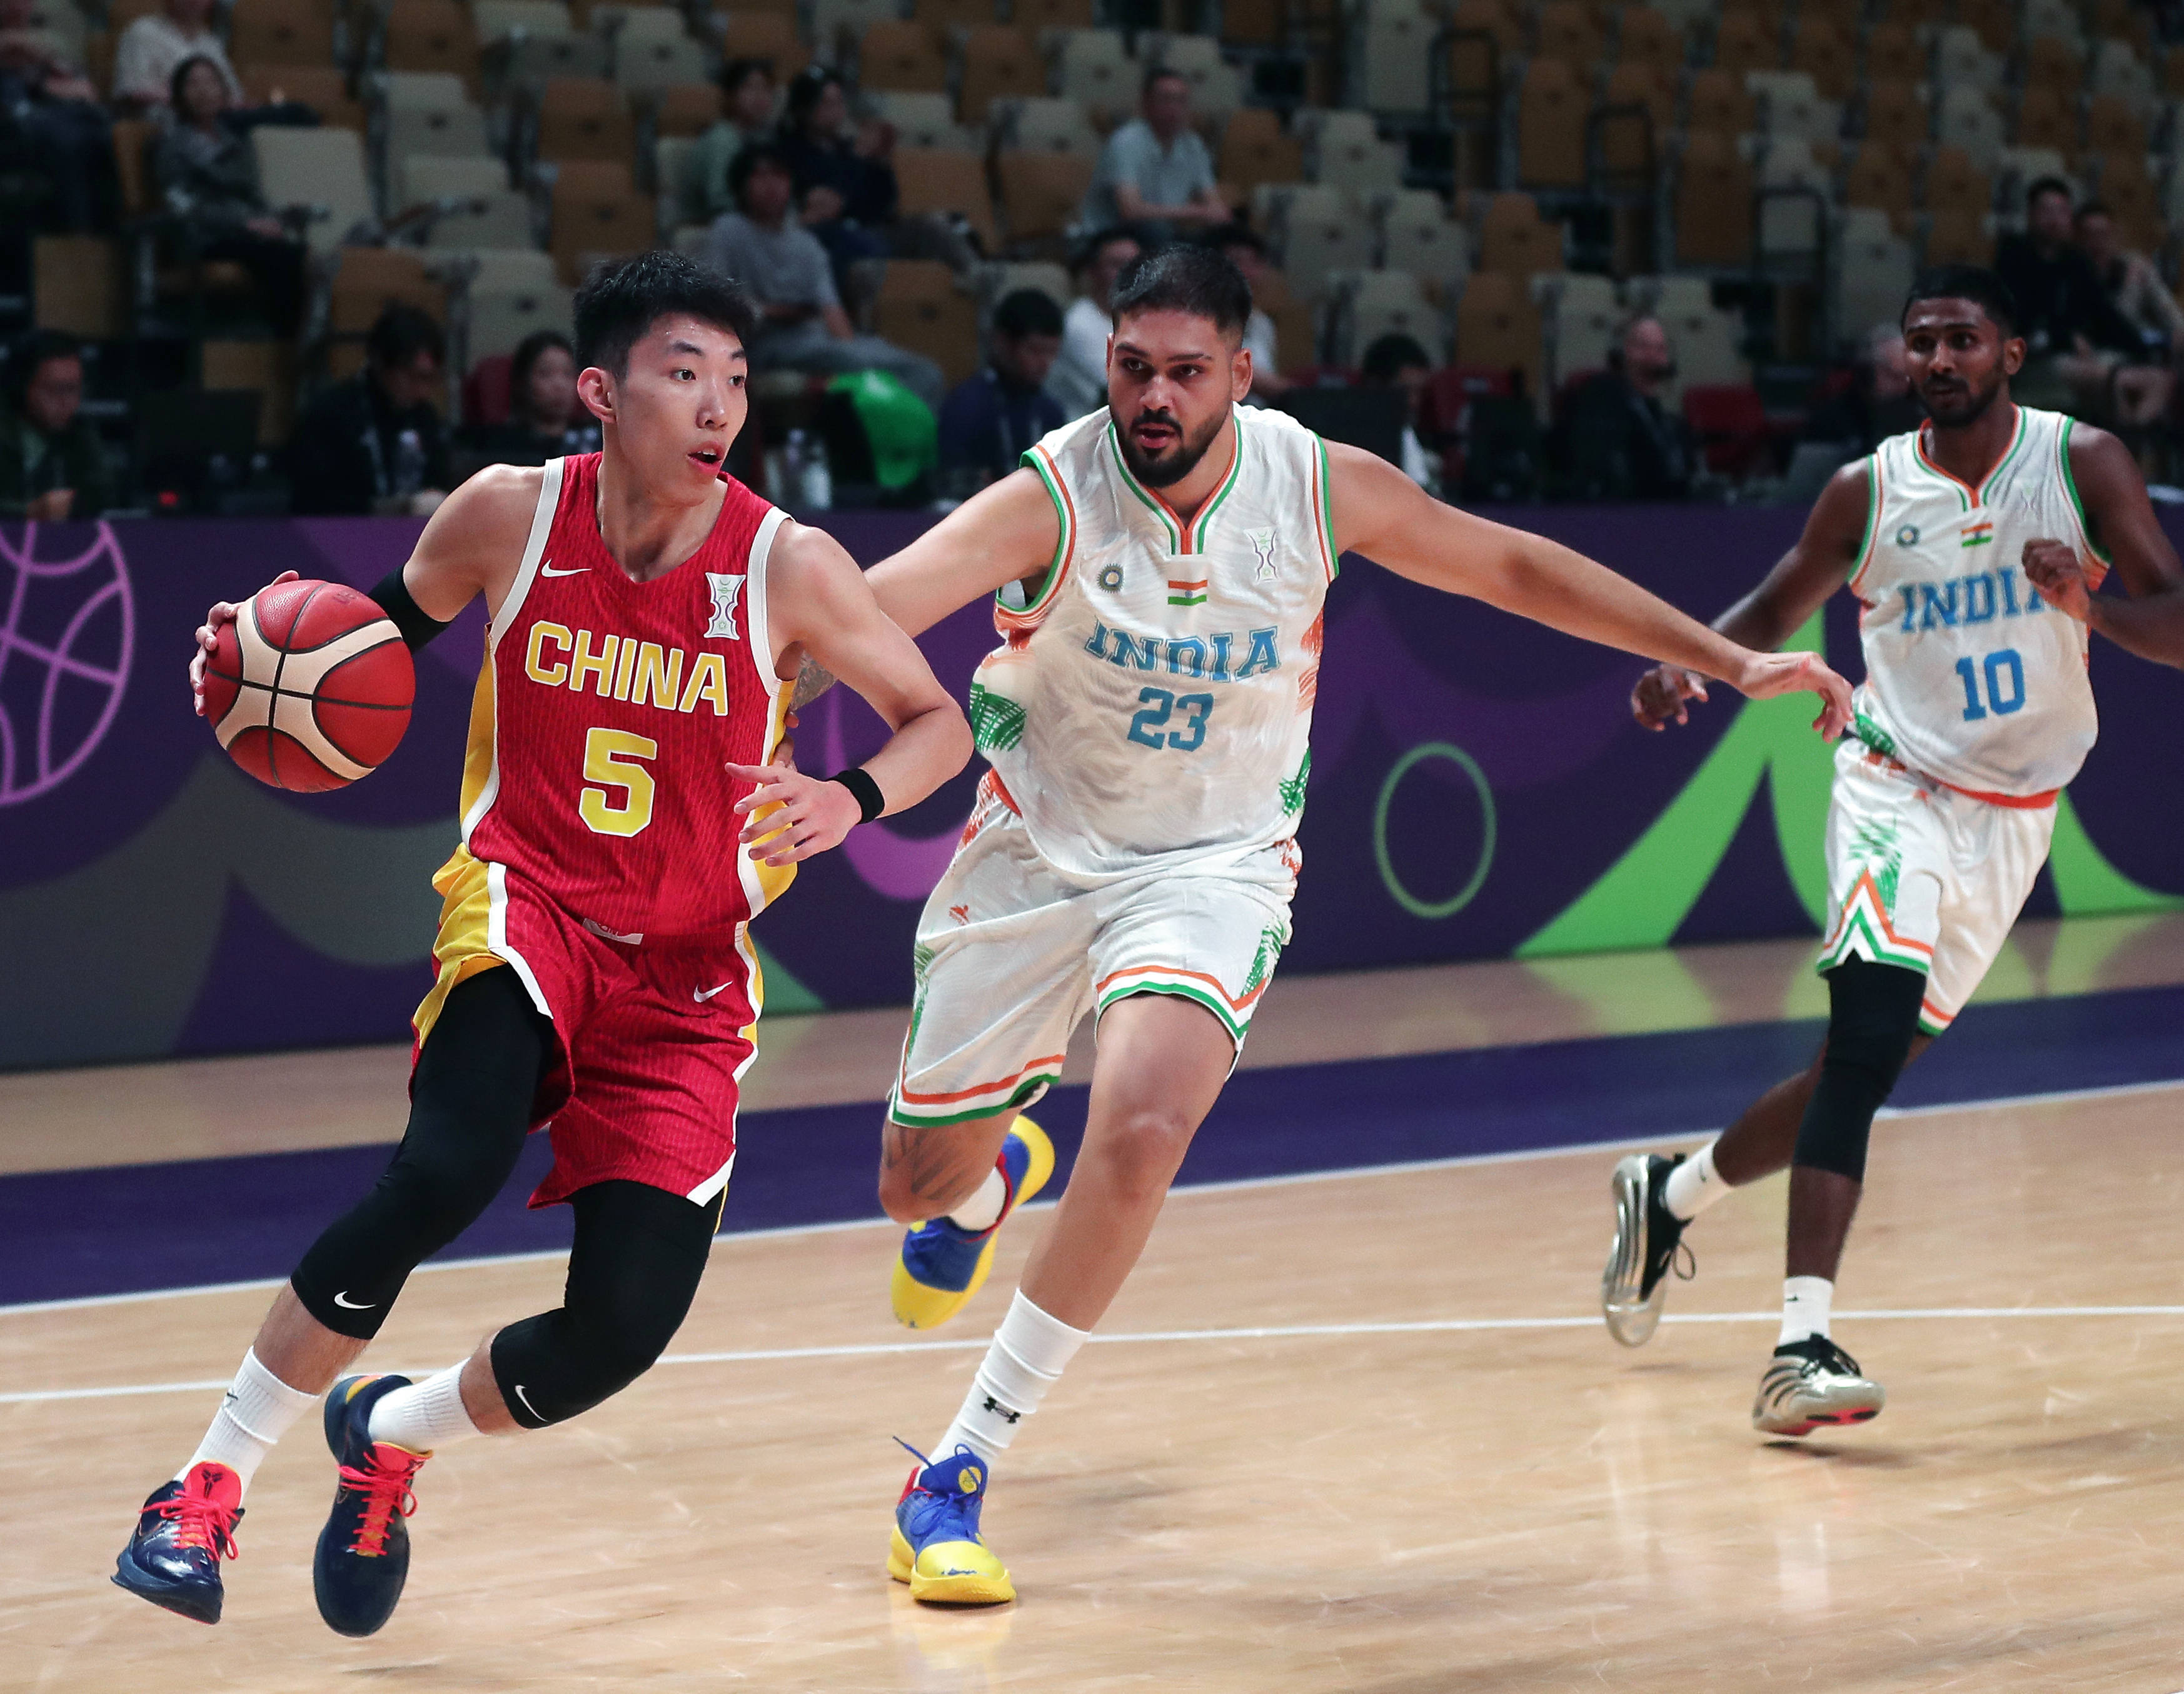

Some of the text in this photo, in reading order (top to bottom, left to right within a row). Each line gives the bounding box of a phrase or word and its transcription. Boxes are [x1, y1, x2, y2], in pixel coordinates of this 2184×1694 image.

[525, 619, 728, 716] CHINA
[1084, 617, 1281, 683] INDIA
[1955, 648, 2026, 721] 10
[1127, 686, 1214, 752] 23
[578, 726, 657, 838] 5
